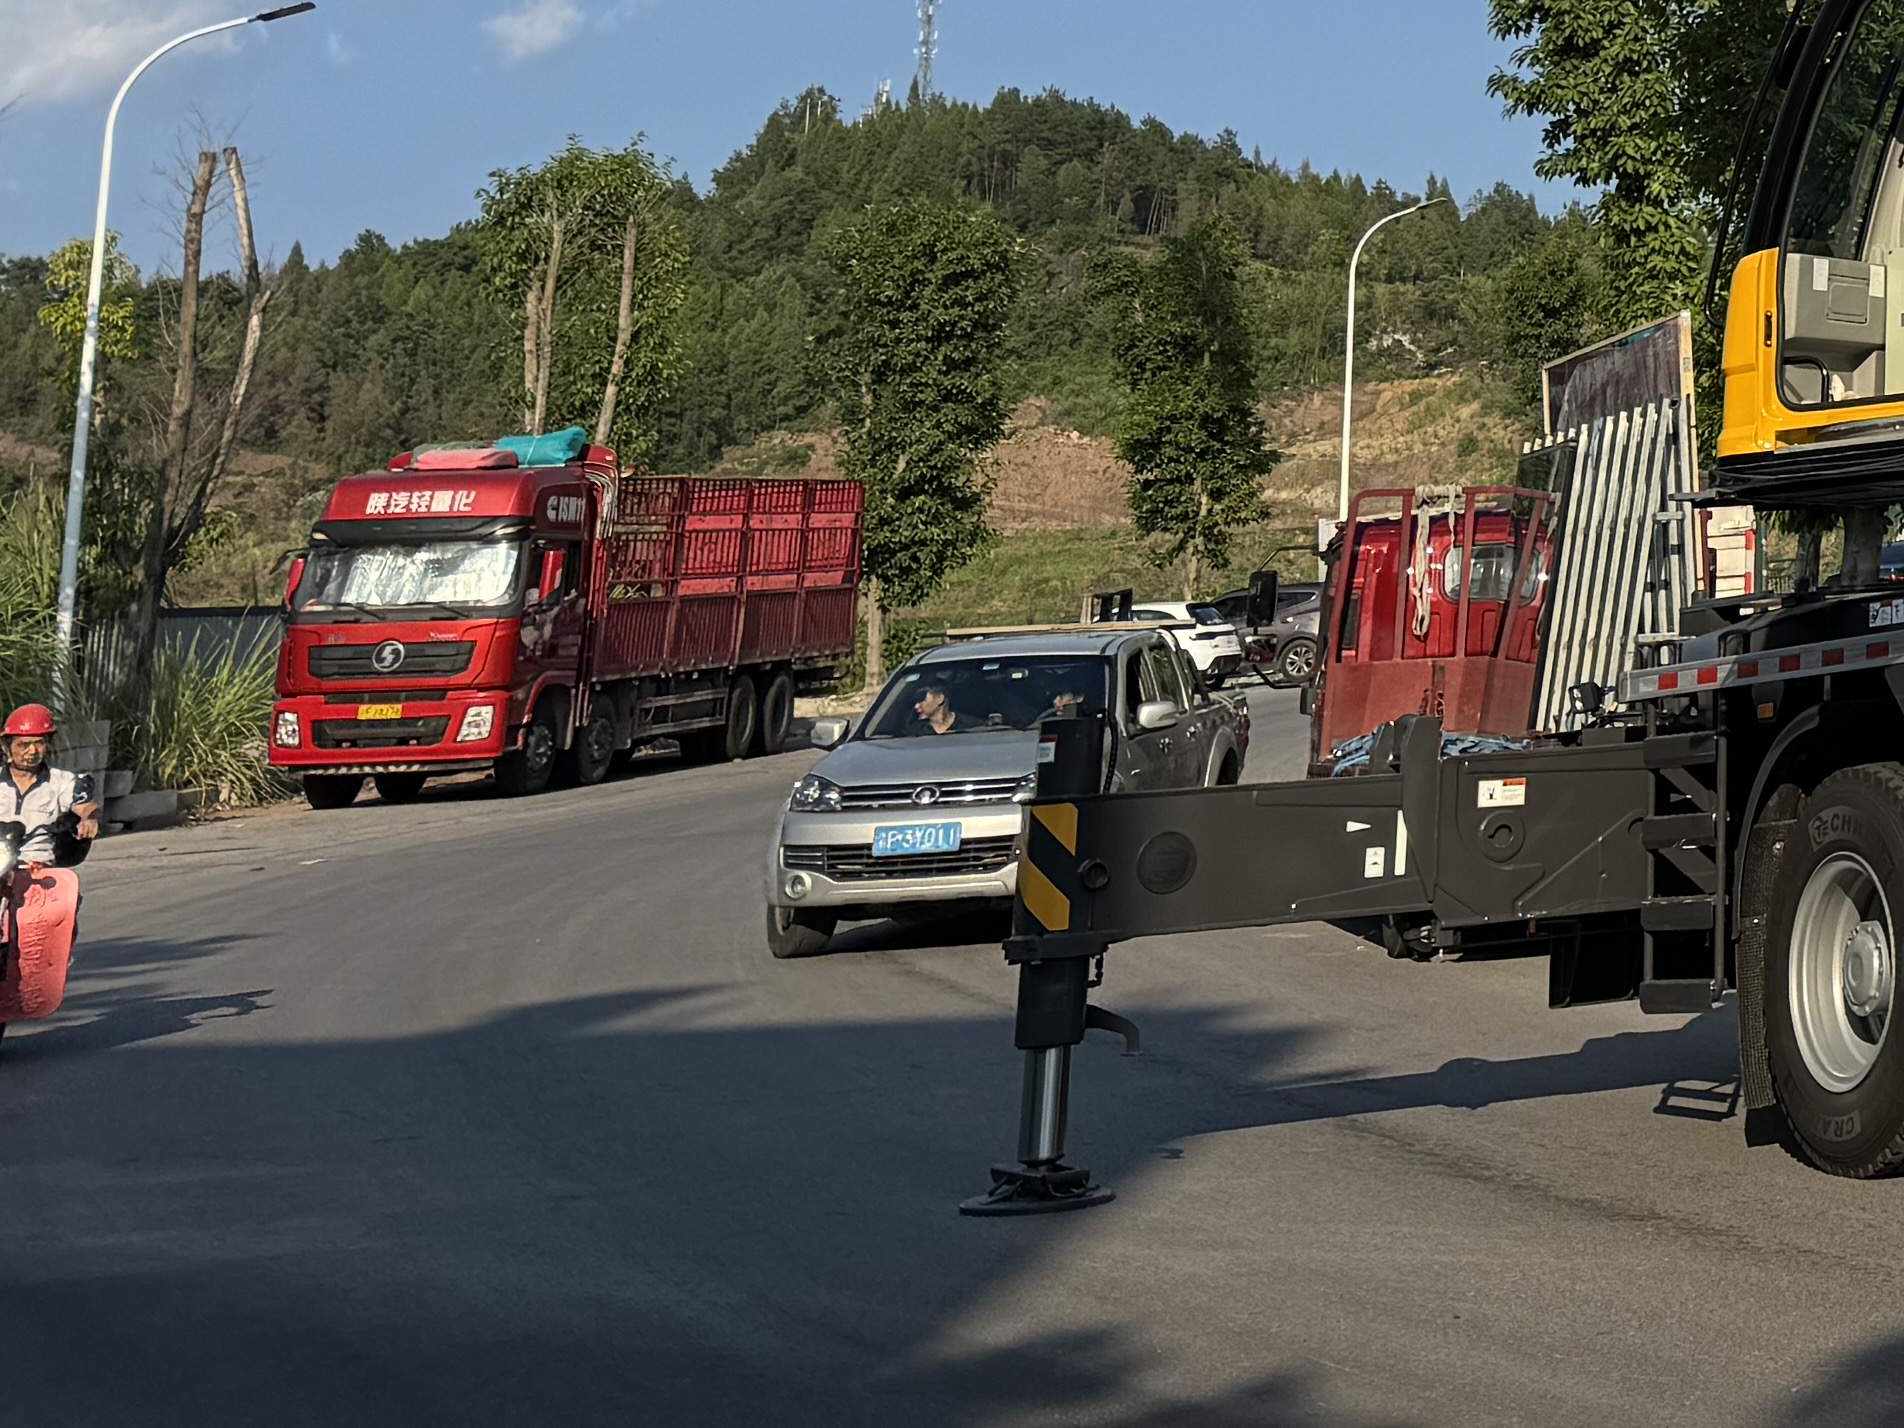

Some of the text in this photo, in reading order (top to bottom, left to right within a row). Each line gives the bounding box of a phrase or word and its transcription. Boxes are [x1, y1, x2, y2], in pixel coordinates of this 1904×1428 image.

[365, 490, 476, 515] 陕汽轻量化
